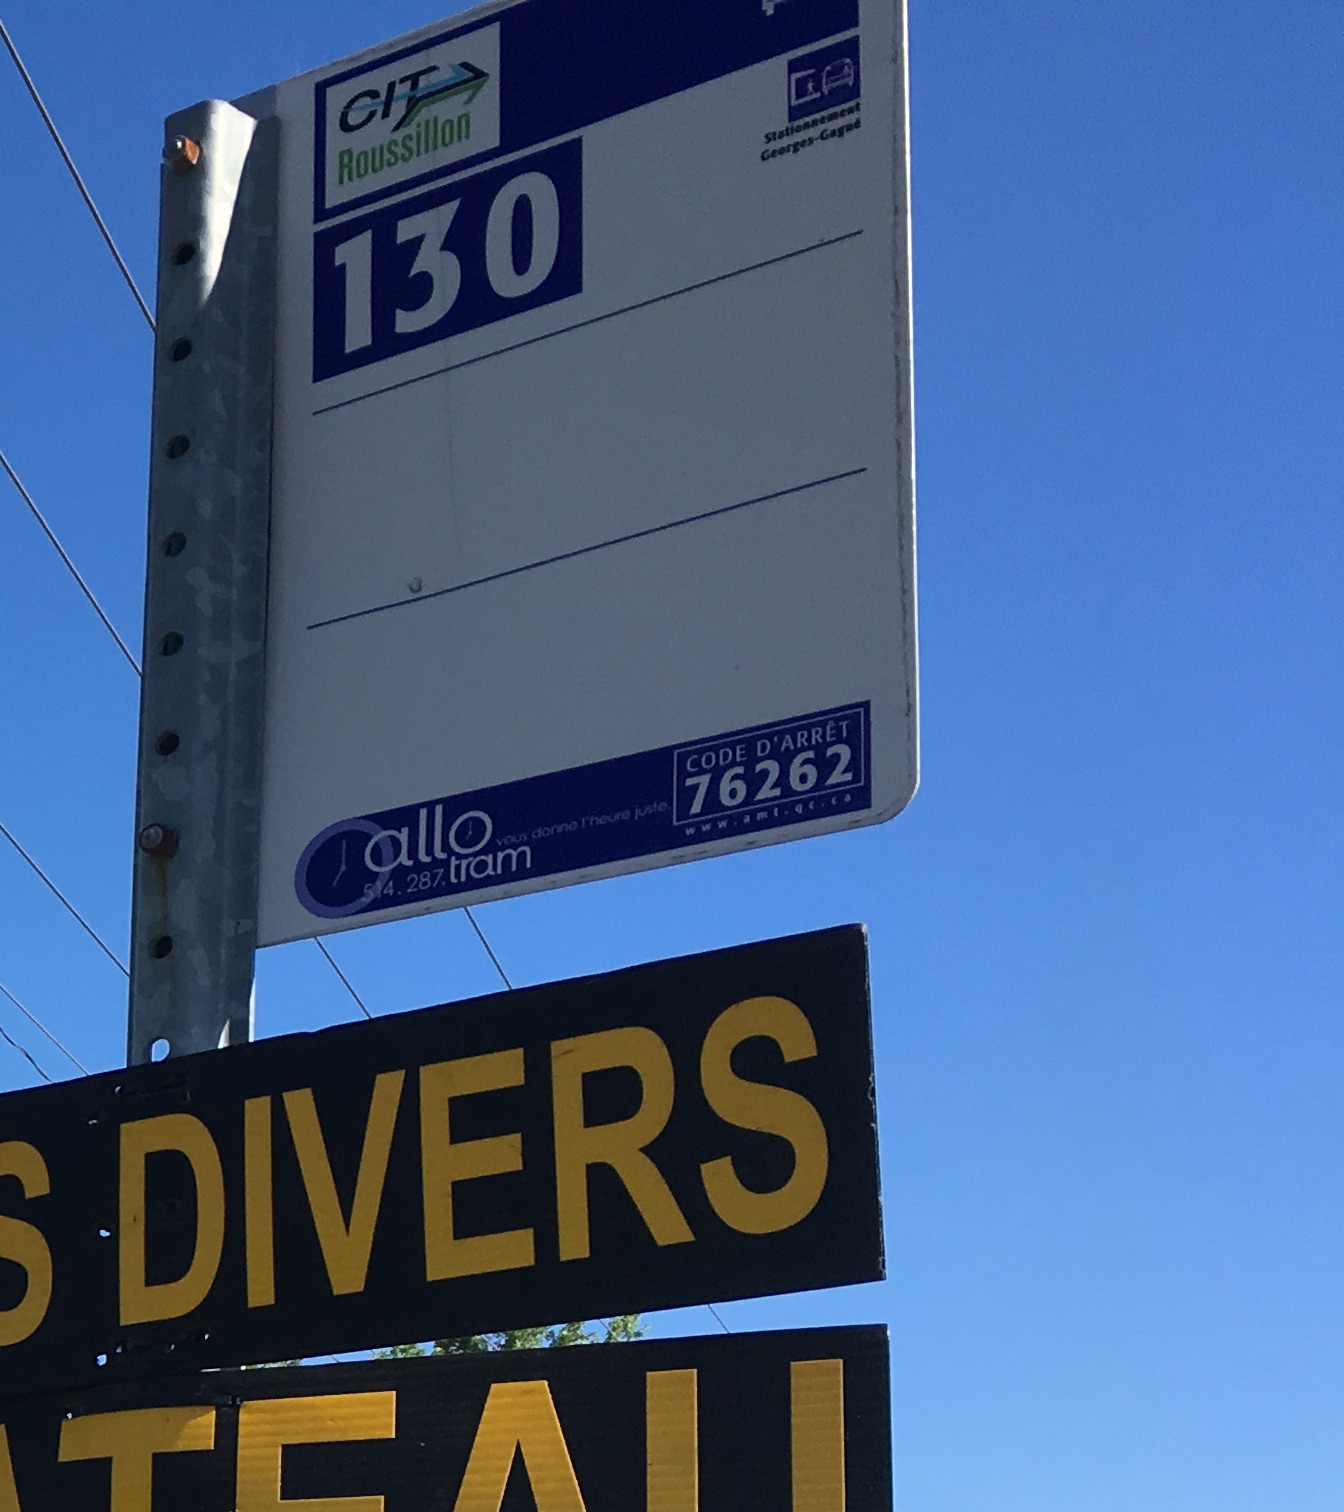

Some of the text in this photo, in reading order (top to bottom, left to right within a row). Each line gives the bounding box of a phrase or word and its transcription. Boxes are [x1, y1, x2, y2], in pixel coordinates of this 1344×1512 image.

[339, 64, 440, 134] CIT
[763, 101, 862, 144] Stationnement
[338, 112, 471, 186] Roussillon
[760, 117, 862, 162] Georges-Gagné
[334, 170, 561, 355] 130
[685, 743, 854, 816] 76262
[686, 719, 851, 773] CODE D'ARRÊT
[364, 803, 494, 873] allo
[496, 832, 528, 847] vous
[531, 820, 579, 839] donne
[581, 808, 631, 829] l'heure
[449, 845, 532, 884] tram
[117, 994, 831, 1329] DIVERS
